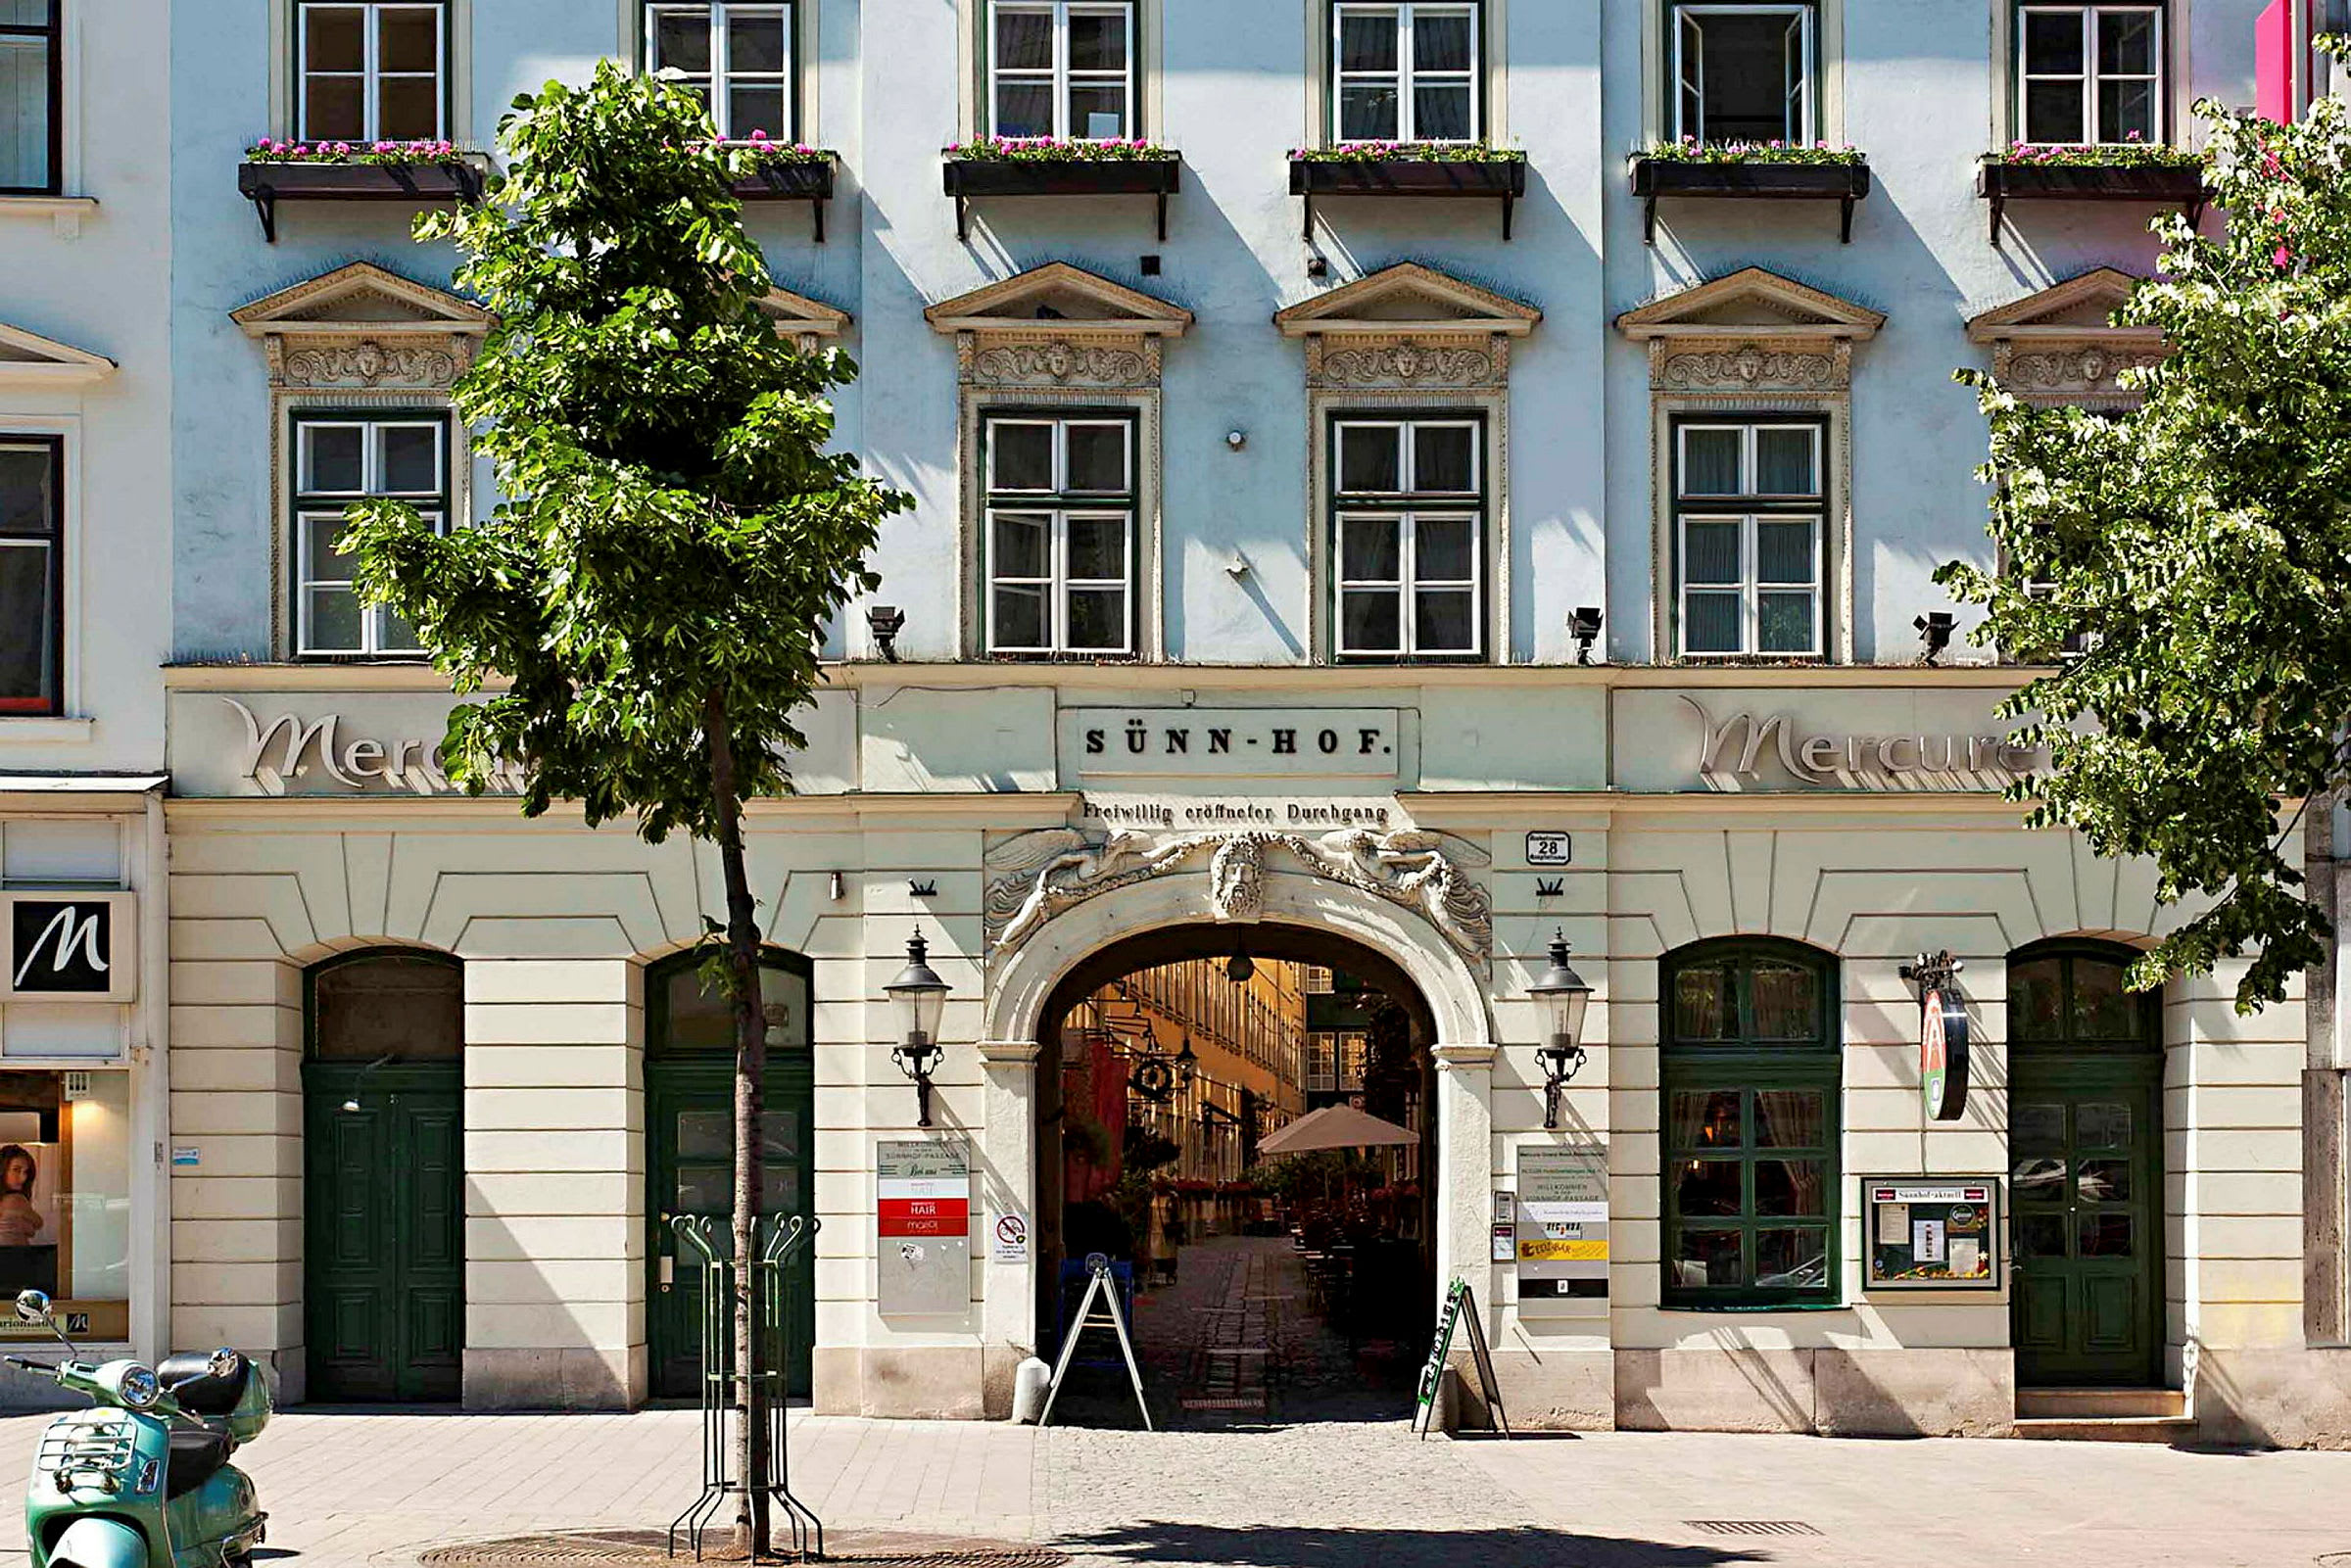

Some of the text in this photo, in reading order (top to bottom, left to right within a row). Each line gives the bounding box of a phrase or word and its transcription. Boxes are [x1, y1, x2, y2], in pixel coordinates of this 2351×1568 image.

[1085, 718, 1392, 754] SÜNN-HOF.
[1678, 693, 2039, 784] Mercure
[1082, 802, 1387, 824] Freiwillig eröffneter Durchgang
[1539, 841, 1558, 854] 28
[911, 1206, 936, 1215] HAIR
